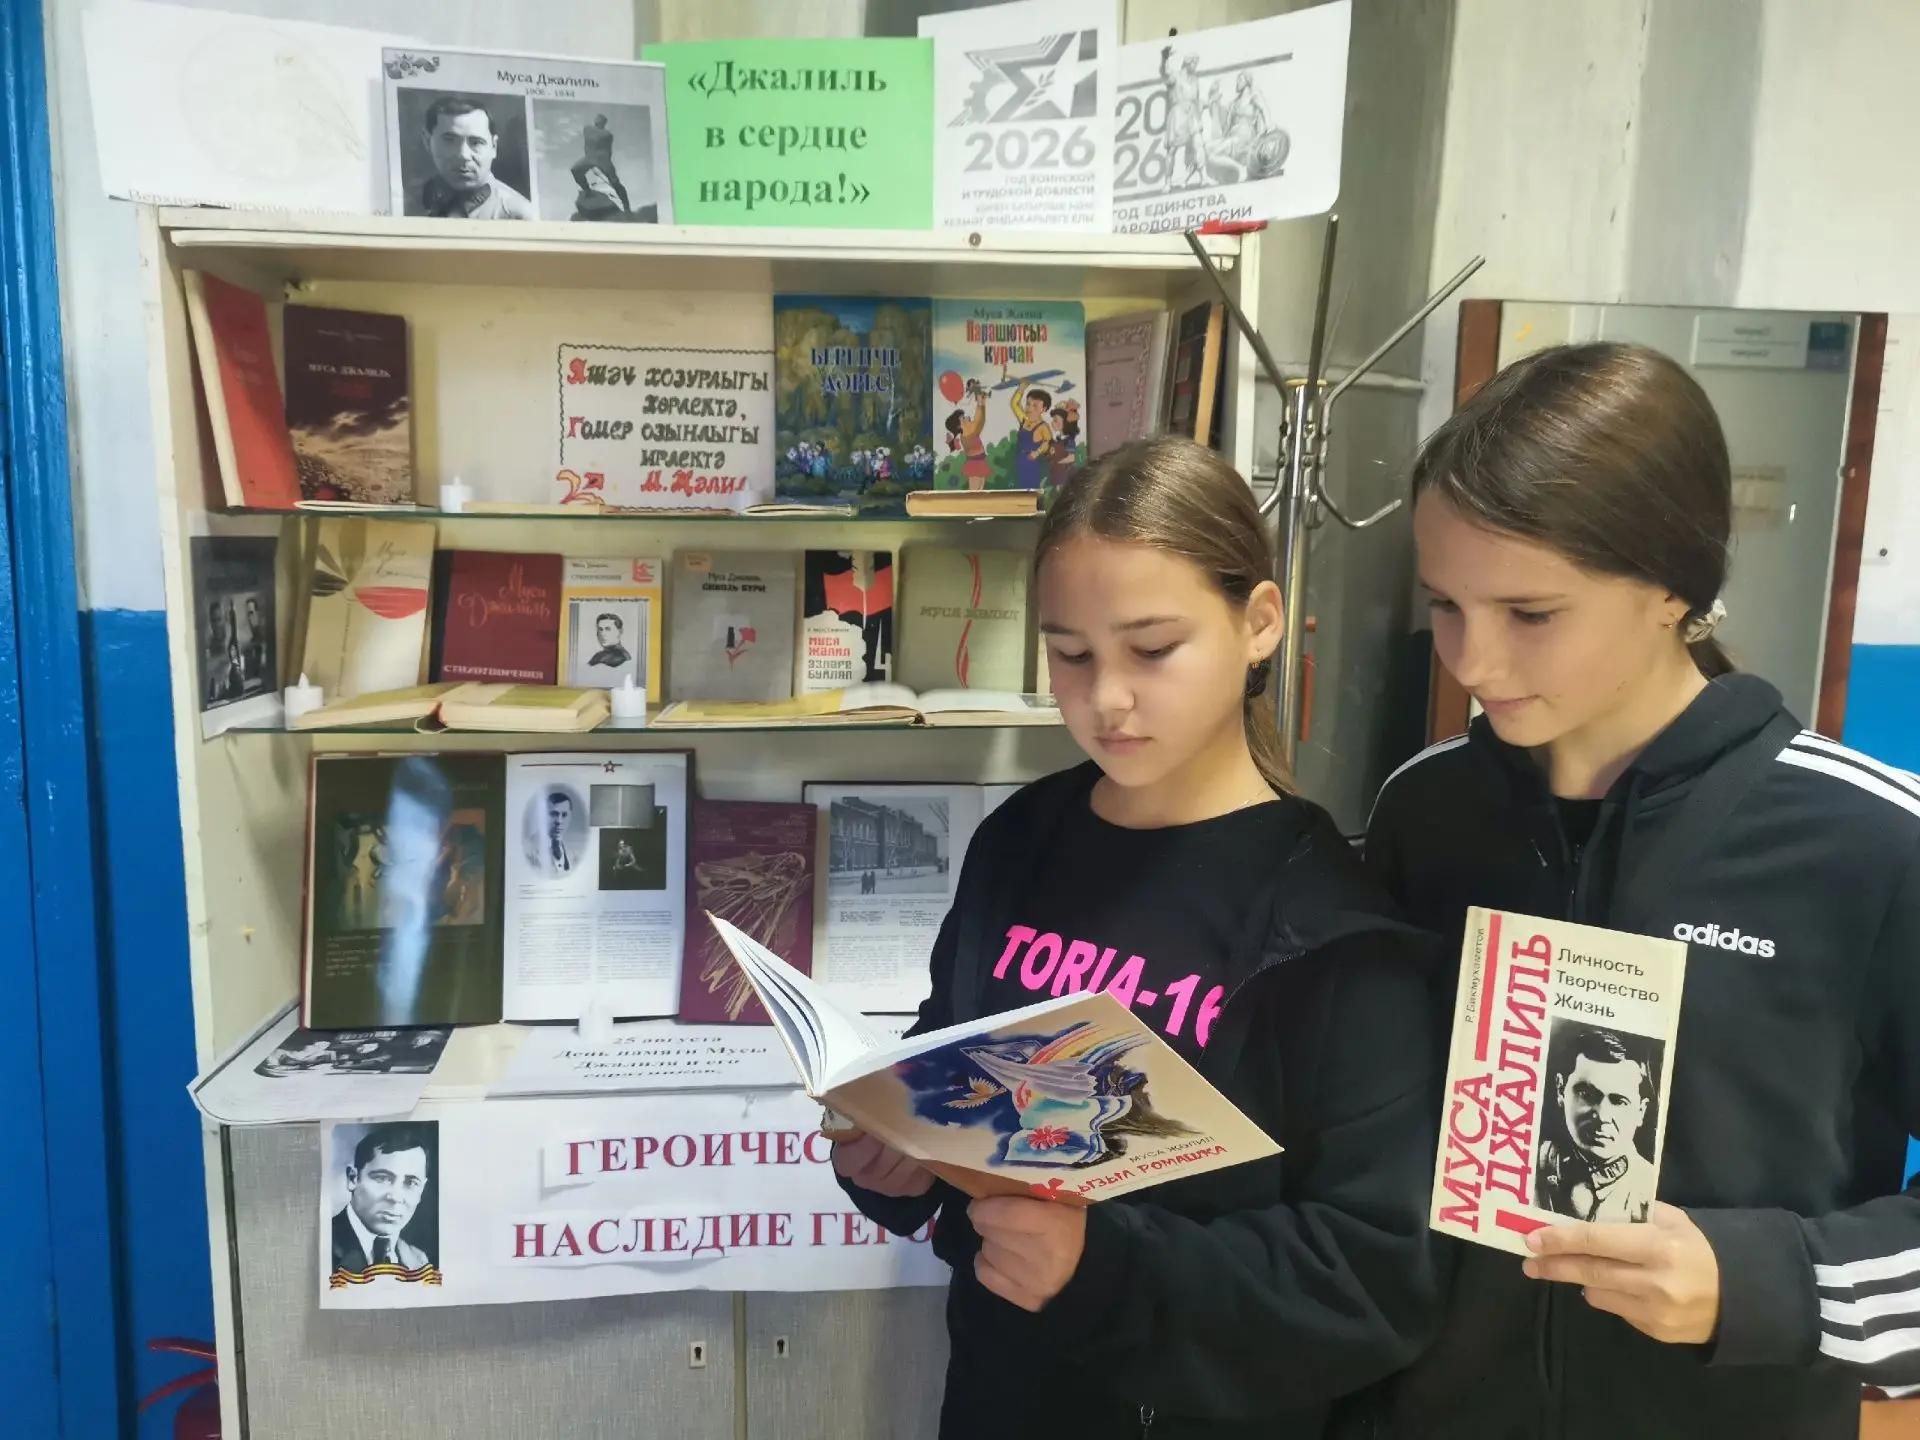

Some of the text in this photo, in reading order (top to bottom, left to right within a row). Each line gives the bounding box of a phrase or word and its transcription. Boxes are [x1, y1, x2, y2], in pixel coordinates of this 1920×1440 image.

[497, 70, 600, 88] Муса Джалиль
[687, 60, 888, 95] «Джалиль
[705, 122, 868, 156] в сердце
[964, 126, 1096, 173] 2026
[698, 172, 871, 209] народа!»
[1145, 194, 1227, 218] ЕДИНСТВА
[1186, 206, 1252, 229] РОССИИ
[967, 319, 1048, 344] Парашютсыз
[984, 345, 1034, 365] курчак
[567, 416, 760, 445] Гомер озынлыгы
[1674, 923, 1776, 958] adidas
[1557, 948, 1645, 977] Личность
[1556, 970, 1660, 1004] Творчество
[1554, 992, 1616, 1019] Жизнь
[1485, 934, 1552, 1205] ДЖАЛИЛЬ
[1137, 1145, 1228, 1174] РОМАШКА
[1439, 1073, 1493, 1233] МУСА
[512, 1212, 795, 1260] НАСЛЕДИЕ
